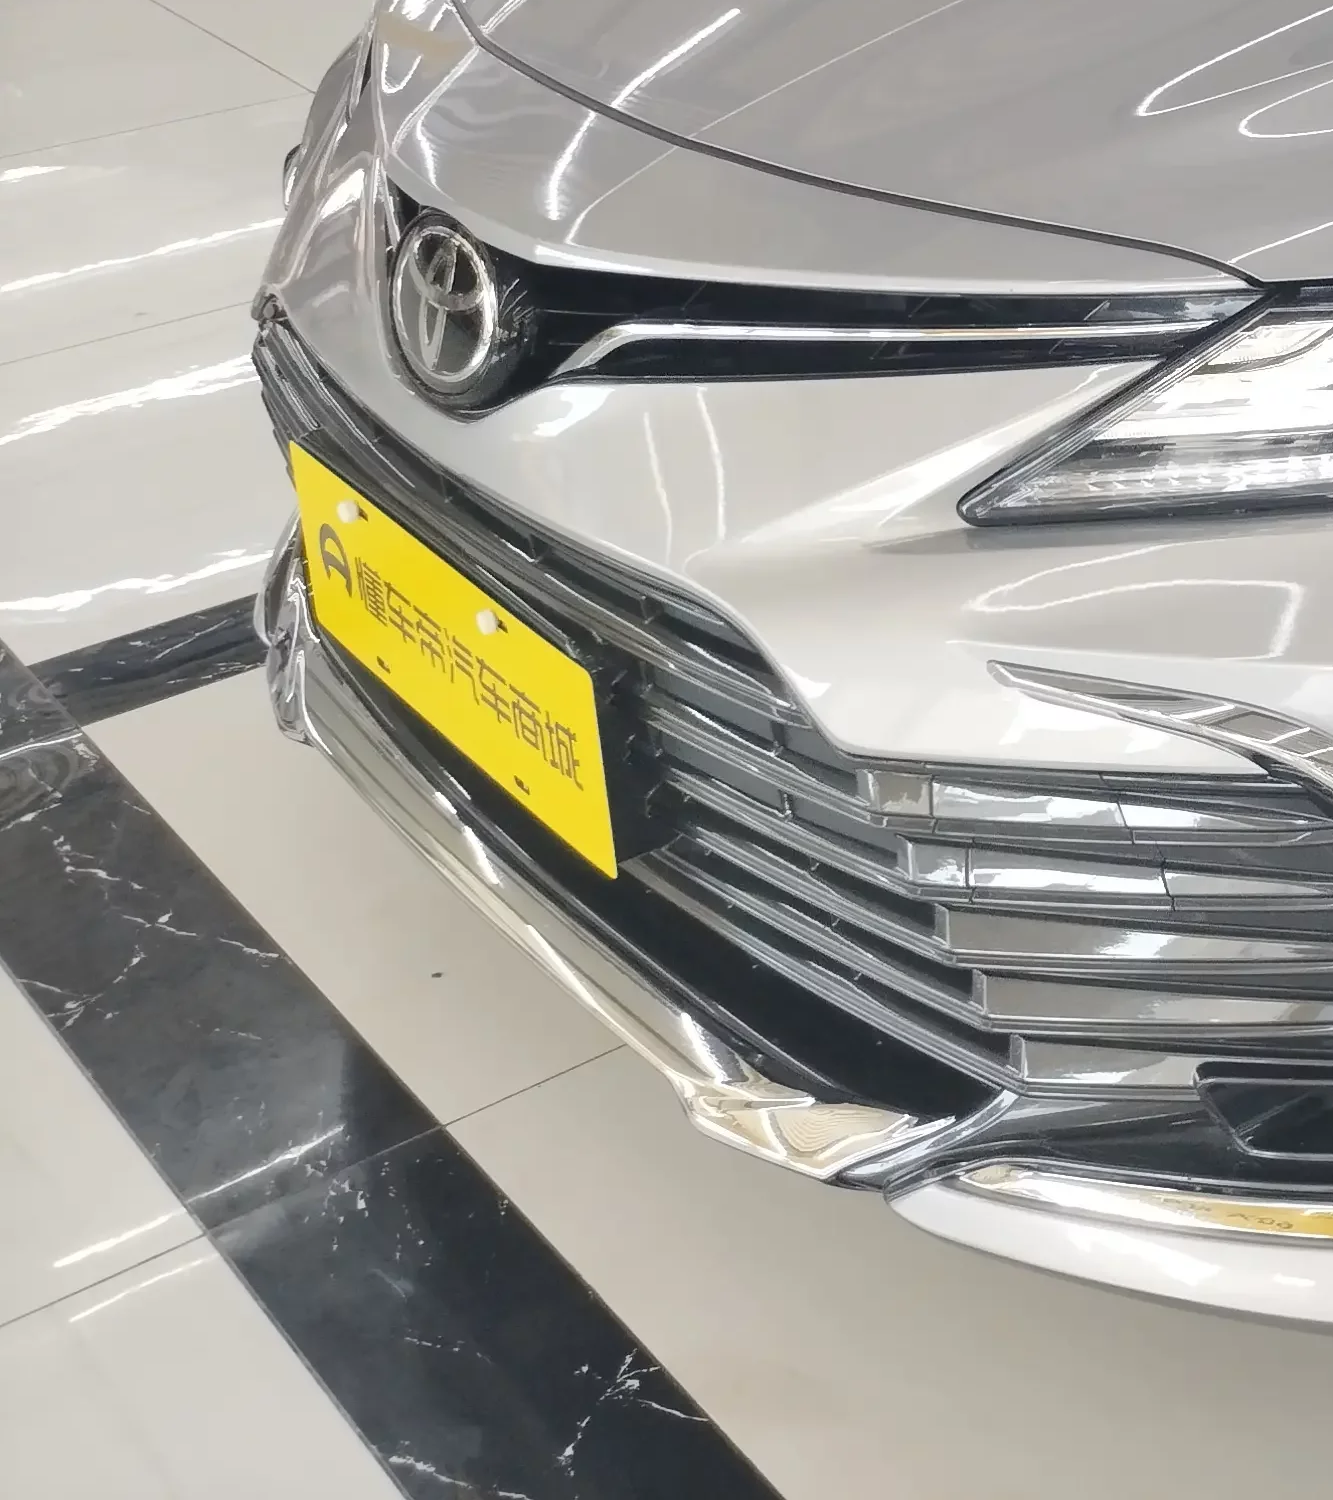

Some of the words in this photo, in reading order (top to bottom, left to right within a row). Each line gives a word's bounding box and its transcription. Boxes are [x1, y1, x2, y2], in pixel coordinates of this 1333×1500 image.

[355, 556, 585, 791] 懂车帝汽车商城
